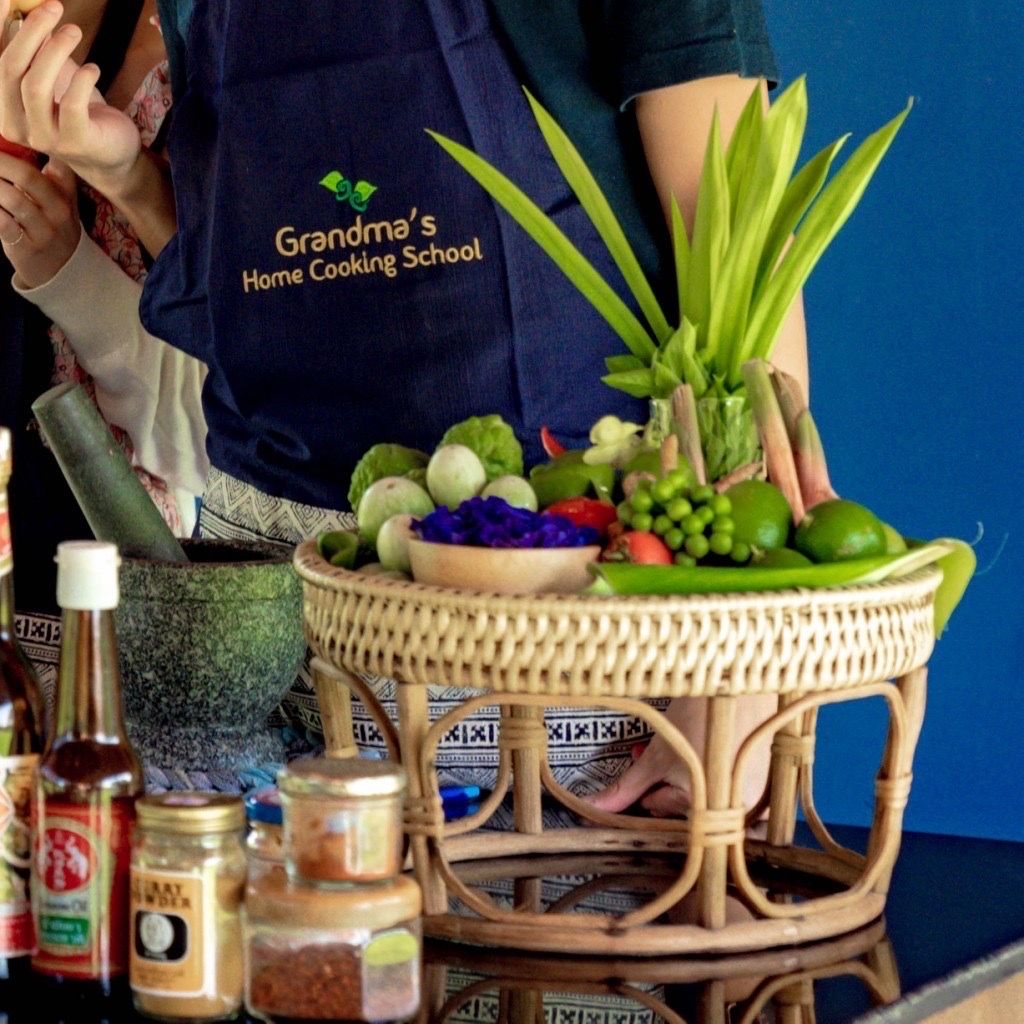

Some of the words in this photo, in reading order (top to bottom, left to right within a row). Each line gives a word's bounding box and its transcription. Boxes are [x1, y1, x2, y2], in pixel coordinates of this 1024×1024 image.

[275, 206, 438, 257] Grandma's
[242, 266, 304, 294] Home
[308, 250, 398, 279] Cooking
[402, 236, 484, 269] School
